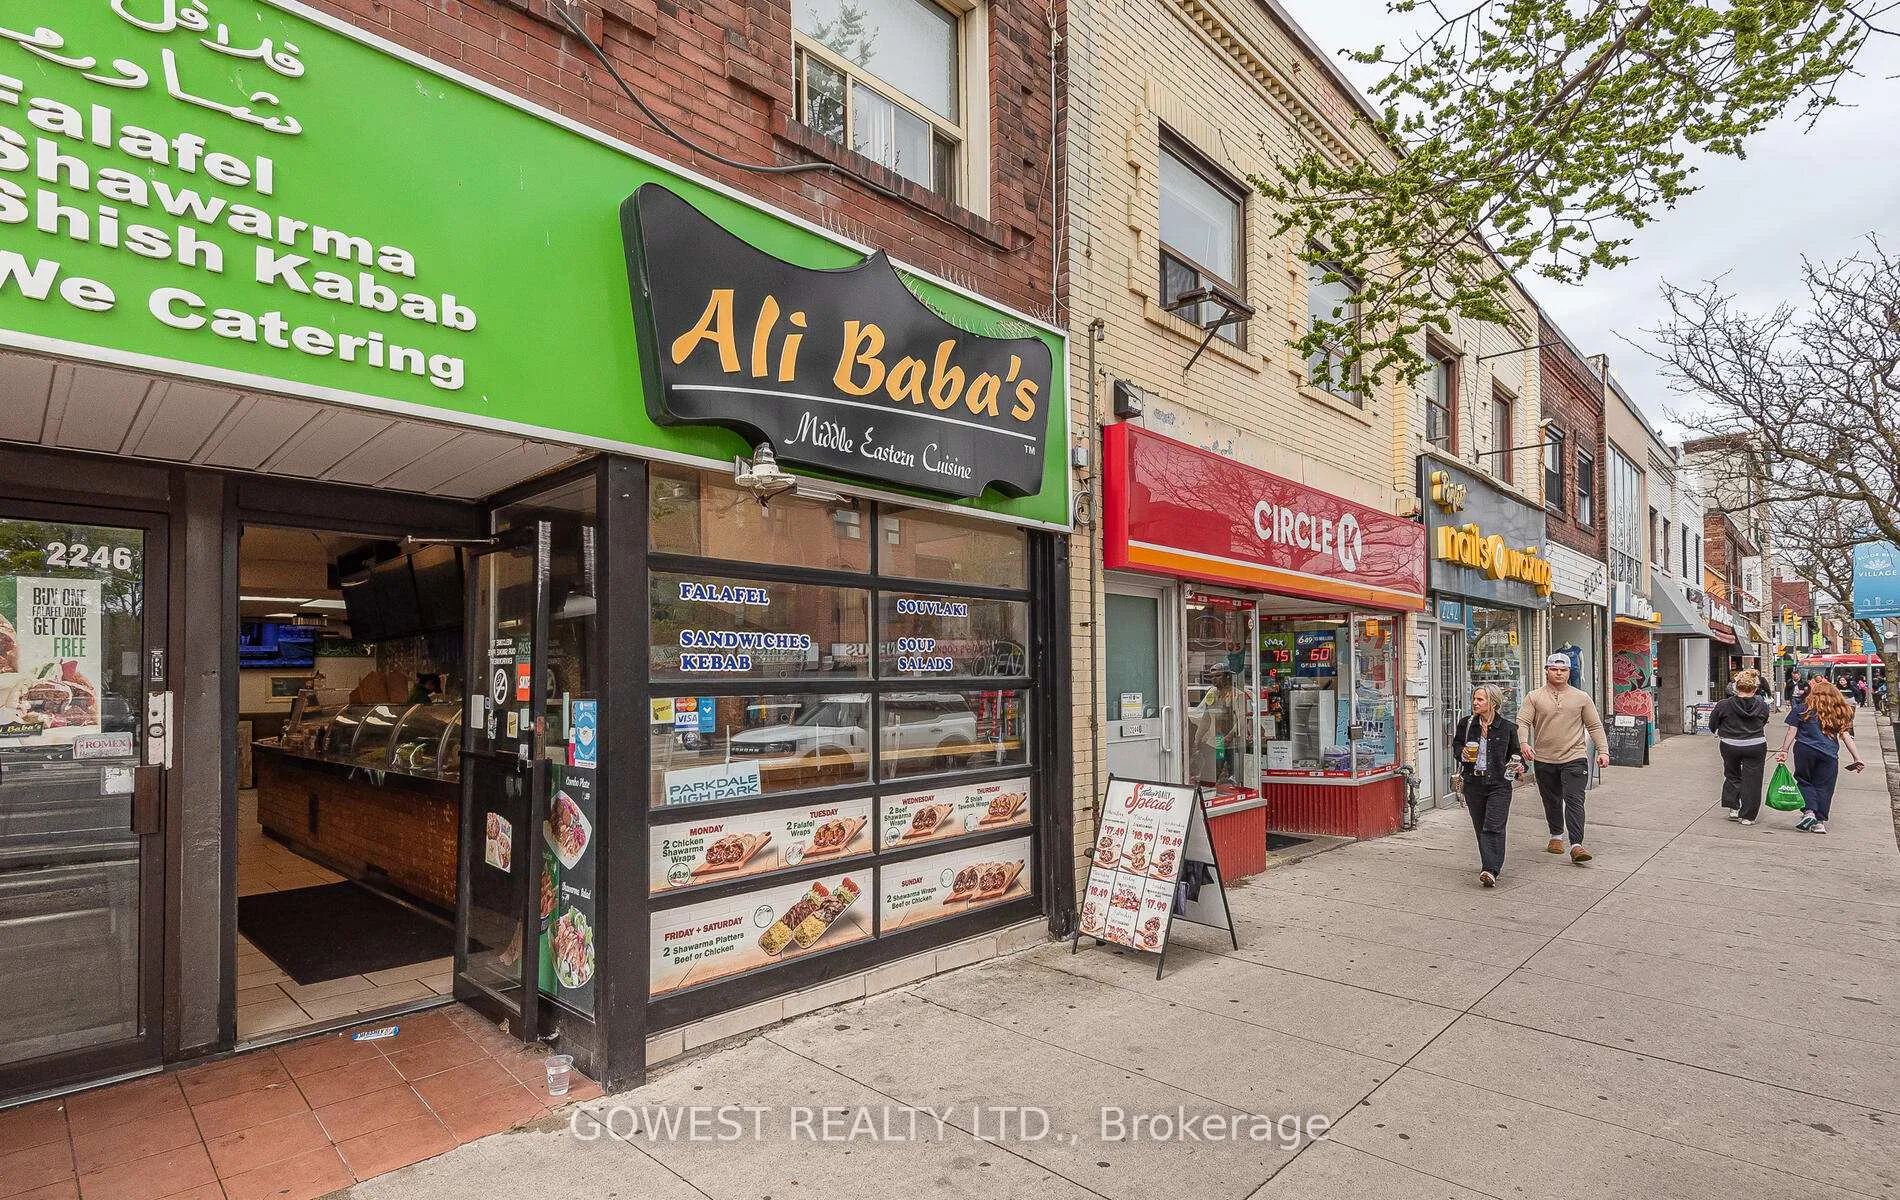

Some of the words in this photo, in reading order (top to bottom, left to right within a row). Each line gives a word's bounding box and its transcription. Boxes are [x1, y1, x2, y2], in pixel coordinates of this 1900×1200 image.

[0, 125, 416, 278] Shawarma
[0, 178, 223, 273] Shish
[256, 245, 477, 332] Kabab
[148, 287, 465, 390] Catering
[671, 289, 807, 382] Ali
[833, 320, 1040, 422] Baba's
[784, 411, 853, 454] Middle
[860, 426, 915, 467] Eastern
[922, 443, 972, 480] Cuisine
[1024, 444, 1036, 455] TM
[1253, 500, 1333, 556] CIRCLE
[1338, 512, 1362, 572] K
[46, 542, 132, 570] 2246
[1438, 522, 1491, 570] nails
[1504, 546, 1552, 597] waxing
[1858, 569, 1897, 577] VILLAGE
[33, 588, 58, 605] BUY
[62, 588, 86, 607] ONE
[679, 583, 769, 605] FALAFEL
[32, 606, 62, 617] FALAFEL
[64, 607, 86, 618] WRAP
[897, 600, 968, 617] SOUVLAKI
[33, 618, 58, 636] GET
[62, 618, 86, 636] ONE
[54, 637, 86, 657] FREE
[680, 630, 811, 651] SANDWICHES
[898, 637, 936, 652] SOUP
[1273, 650, 1289, 662] 75
[1310, 648, 1330, 661] 60
[680, 654, 752, 672] KEBAB
[898, 656, 953, 672] SALADS
[678, 714, 697, 723] VISA
[670, 774, 758, 796] PARKDALE
[977, 786, 1001, 795] THURSDAY
[671, 793, 711, 804] HIGH
[715, 784, 758, 800] PARK
[902, 795, 936, 805] WEDNESDAY
[1125, 783, 1175, 814] Special
[809, 808, 839, 818] TUESDAY
[889, 806, 895, 814] 2
[895, 806, 908, 814] Beef
[689, 824, 724, 837] MONDAY
[786, 821, 792, 830] 2
[793, 820, 815, 830] Falafel
[889, 819, 907, 827] Wraps
[790, 828, 811, 837] Wraps
[662, 840, 670, 850] 2
[672, 838, 704, 849] Chicken
[662, 846, 704, 858] Shawarma
[671, 854, 696, 863] Wraps
[901, 876, 923, 887] SUNDAY
[886, 894, 892, 903] 2
[920, 887, 937, 896] Wraps
[891, 901, 905, 909] Beef
[911, 895, 933, 905] Chicken
[664, 927, 695, 941] FRIDAY
[703, 917, 744, 933] SATURDAY
[663, 947, 671, 957] 2
[673, 939, 714, 955] Shawarma
[715, 932, 745, 945] Platters
[674, 953, 693, 965] Beef
[694, 952, 702, 960] or
[704, 944, 734, 957] Chicken
